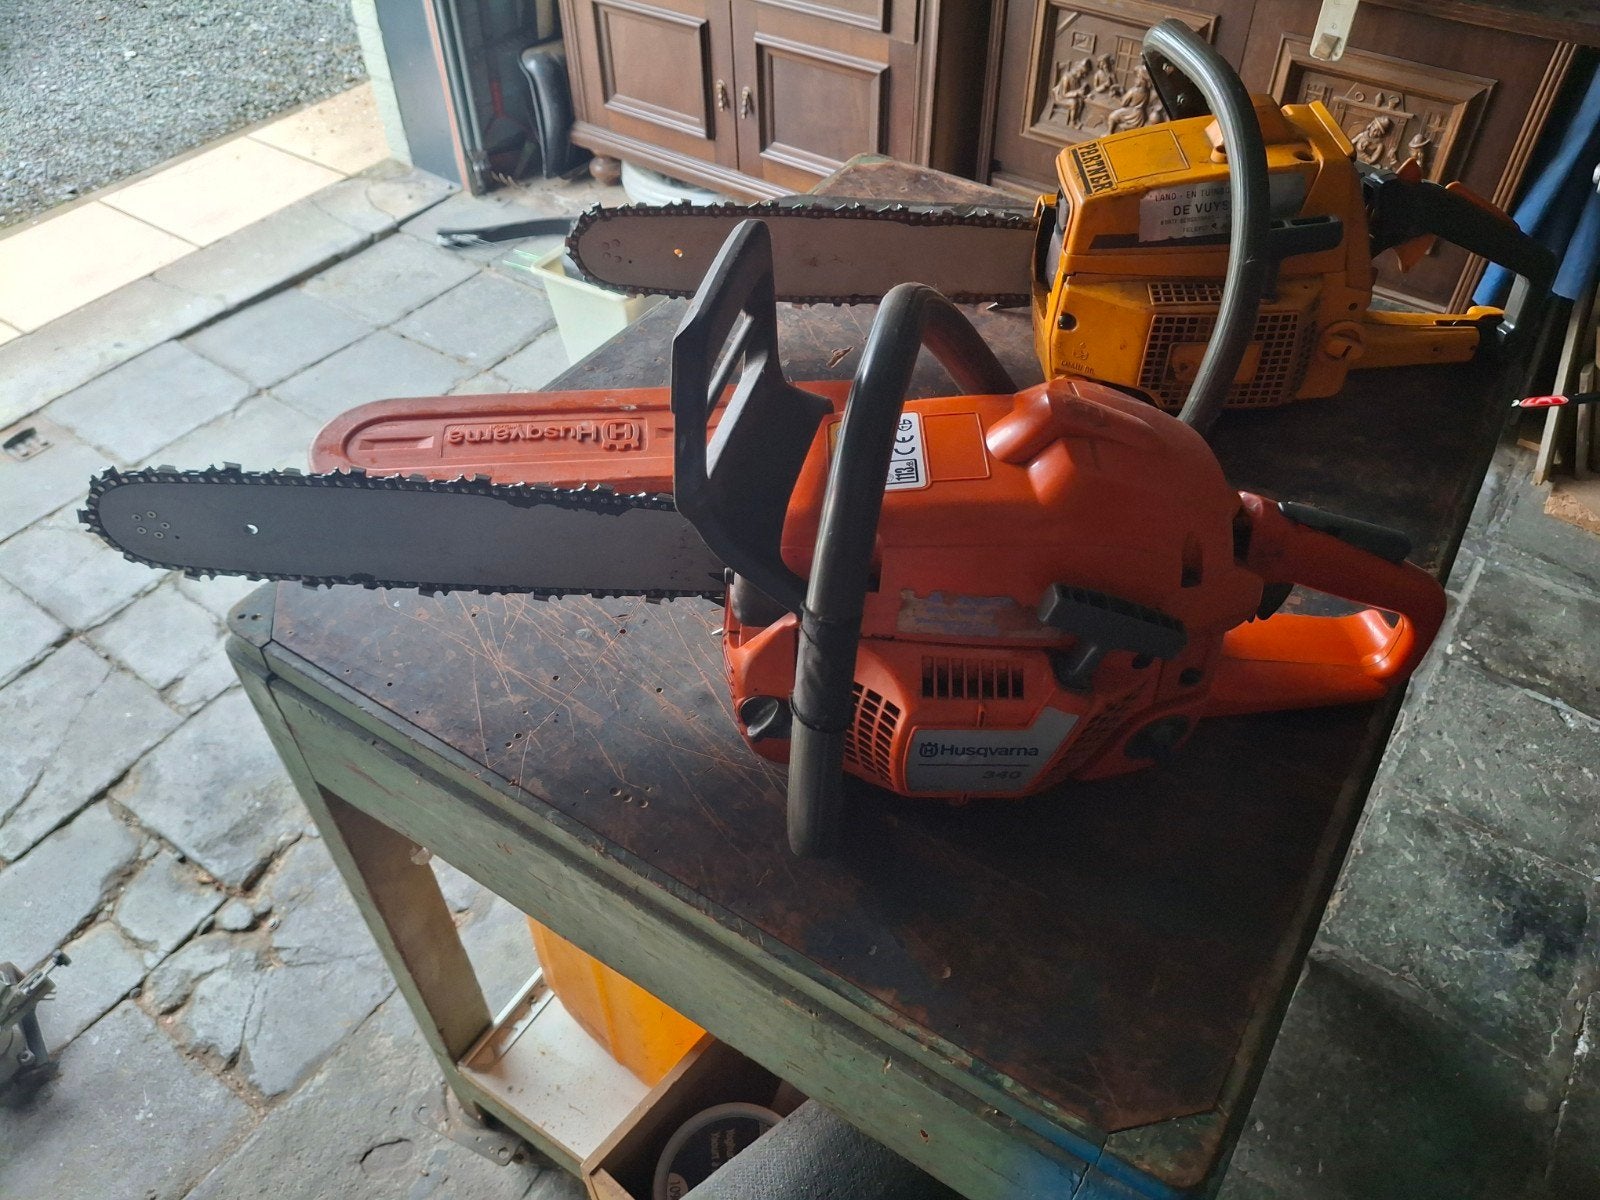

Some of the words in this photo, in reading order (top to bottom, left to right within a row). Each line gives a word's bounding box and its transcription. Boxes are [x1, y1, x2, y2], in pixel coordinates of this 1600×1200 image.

[1078, 142, 1114, 192] PARTNER
[1155, 192, 1177, 202] LAND
[1186, 190, 1197, 199] EN
[1173, 204, 1190, 216] DE
[447, 423, 597, 444] Husqvarna
[894, 467, 915, 481] 113
[941, 744, 1039, 758] Husqvarna
[982, 770, 1022, 780] 340
